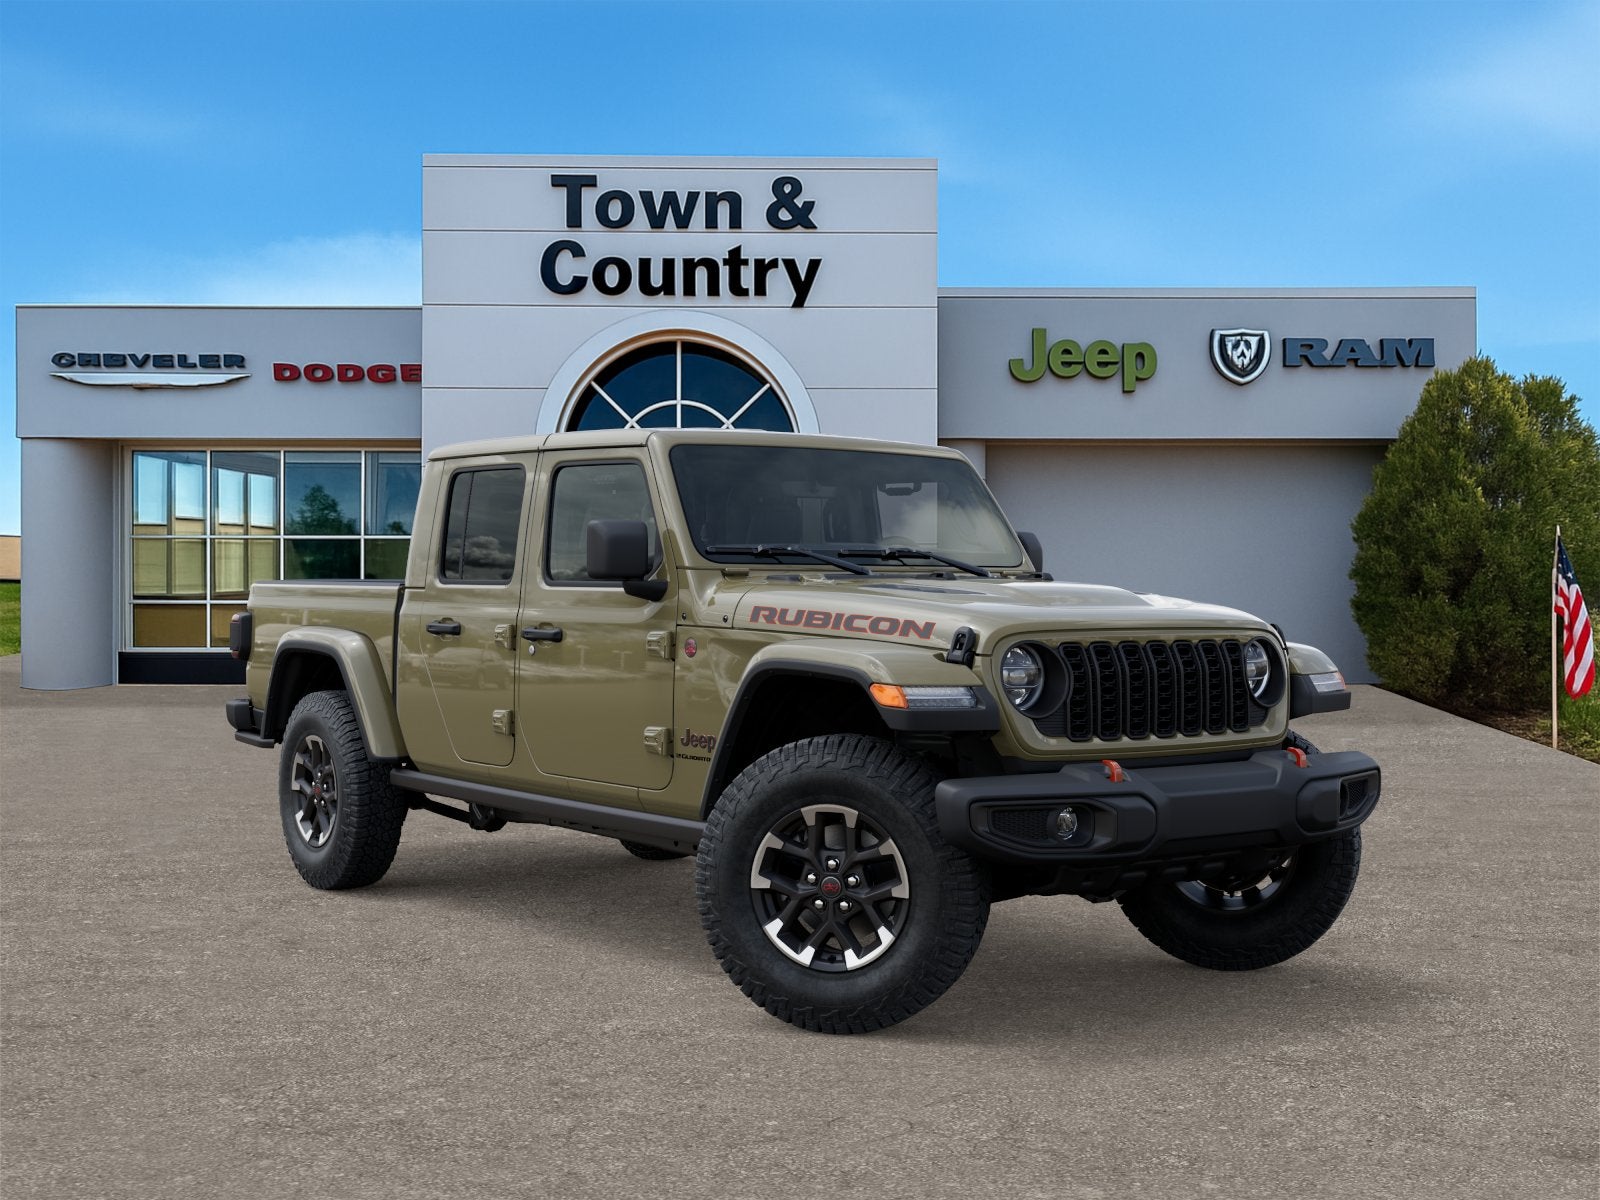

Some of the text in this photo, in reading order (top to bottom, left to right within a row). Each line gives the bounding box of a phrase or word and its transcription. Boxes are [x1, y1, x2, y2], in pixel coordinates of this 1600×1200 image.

[550, 174, 818, 230] Town &
[539, 239, 823, 308] Country
[1009, 328, 1157, 393] Jeep
[1282, 338, 1435, 368] RAM
[273, 363, 422, 383] DODGE
[750, 605, 936, 640] RUBICON
[680, 728, 717, 753] Jeep
